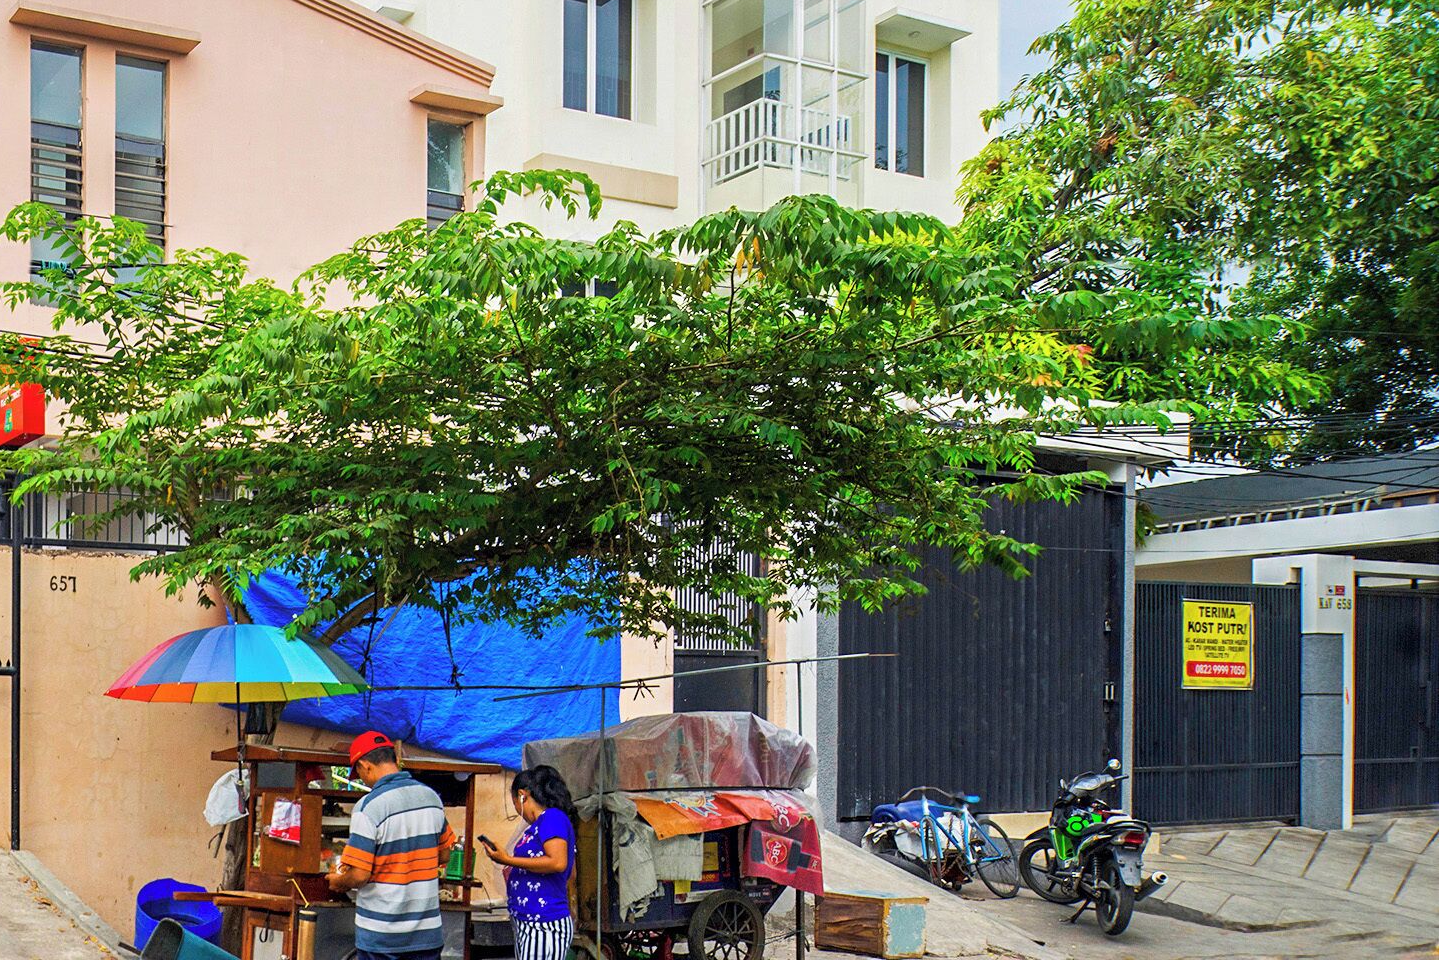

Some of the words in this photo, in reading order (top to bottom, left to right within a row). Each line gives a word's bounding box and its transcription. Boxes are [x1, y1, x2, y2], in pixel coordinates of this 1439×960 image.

[50, 575, 77, 593] 657
[1336, 598, 1352, 610] 658
[1198, 606, 1236, 619] TERIMA
[1188, 621, 1214, 633] KOST
[1217, 622, 1248, 635] PUTRI
[1212, 664, 1229, 675] 9999
[771, 841, 782, 864] ABC
